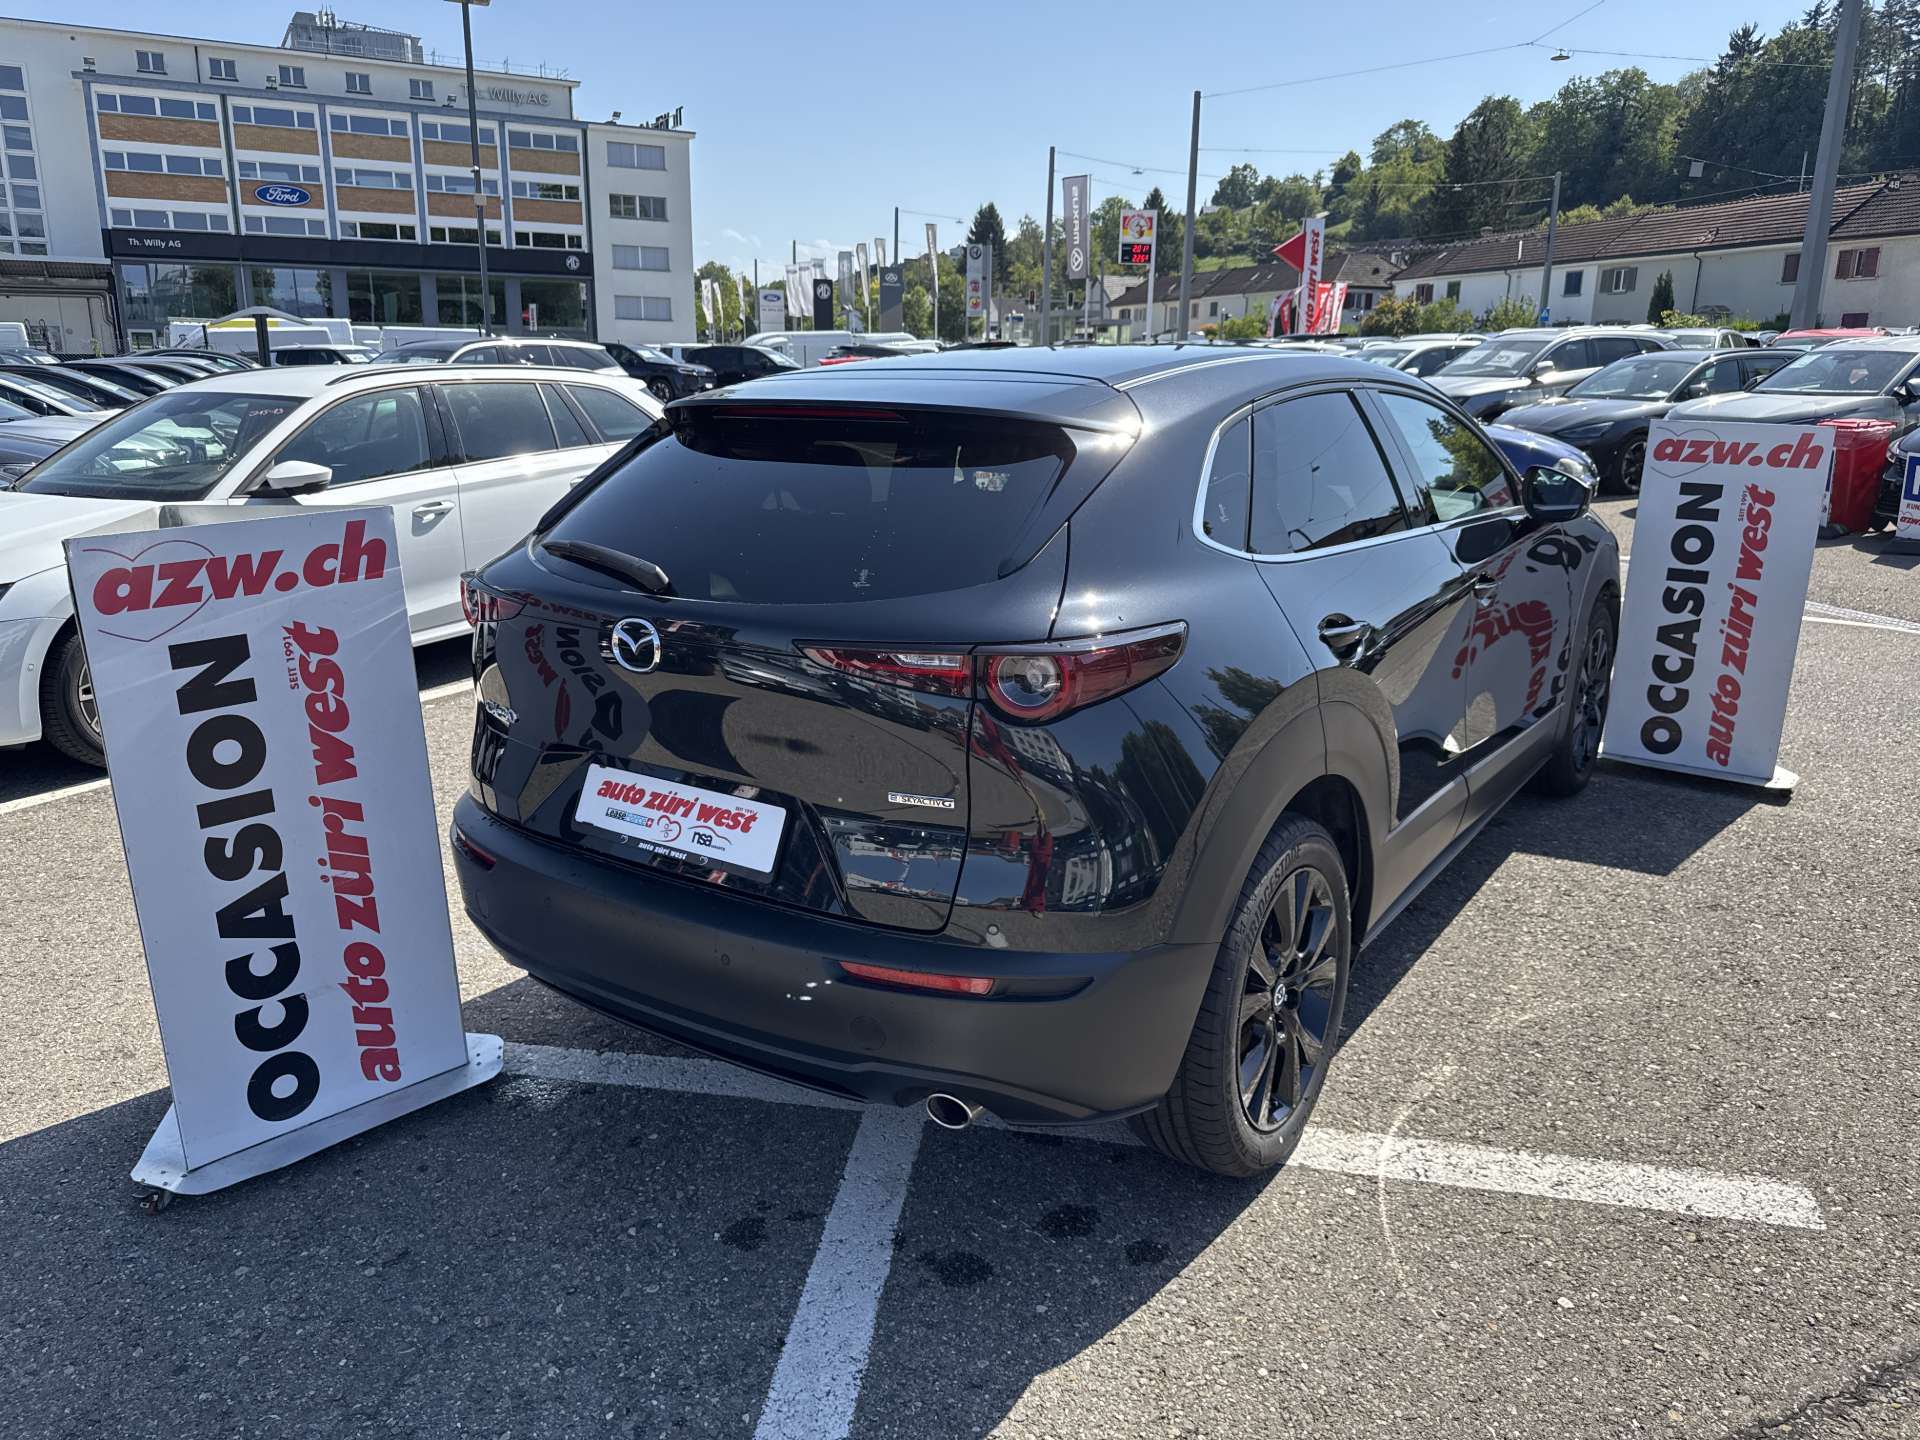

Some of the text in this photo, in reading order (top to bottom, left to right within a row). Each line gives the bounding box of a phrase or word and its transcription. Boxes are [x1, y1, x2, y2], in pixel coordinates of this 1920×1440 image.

[488, 87, 525, 107] Willy
[527, 94, 550, 106] AG
[266, 187, 300, 201] Ford
[128, 238, 181, 249] Th. Willy AG
[1653, 432, 1824, 469] azw.ch
[93, 519, 386, 615] azw.ch
[1640, 481, 1724, 754] OCCASION
[1707, 483, 1776, 766] auto züri west
[283, 636, 299, 690] SEIT 1991
[597, 779, 758, 833] auto züri west
[281, 620, 401, 1082] auto züri west
[638, 842, 654, 851] auto
[670, 849, 688, 860] west
[692, 831, 713, 847] nsa
[168, 633, 320, 1122] OCCASION
